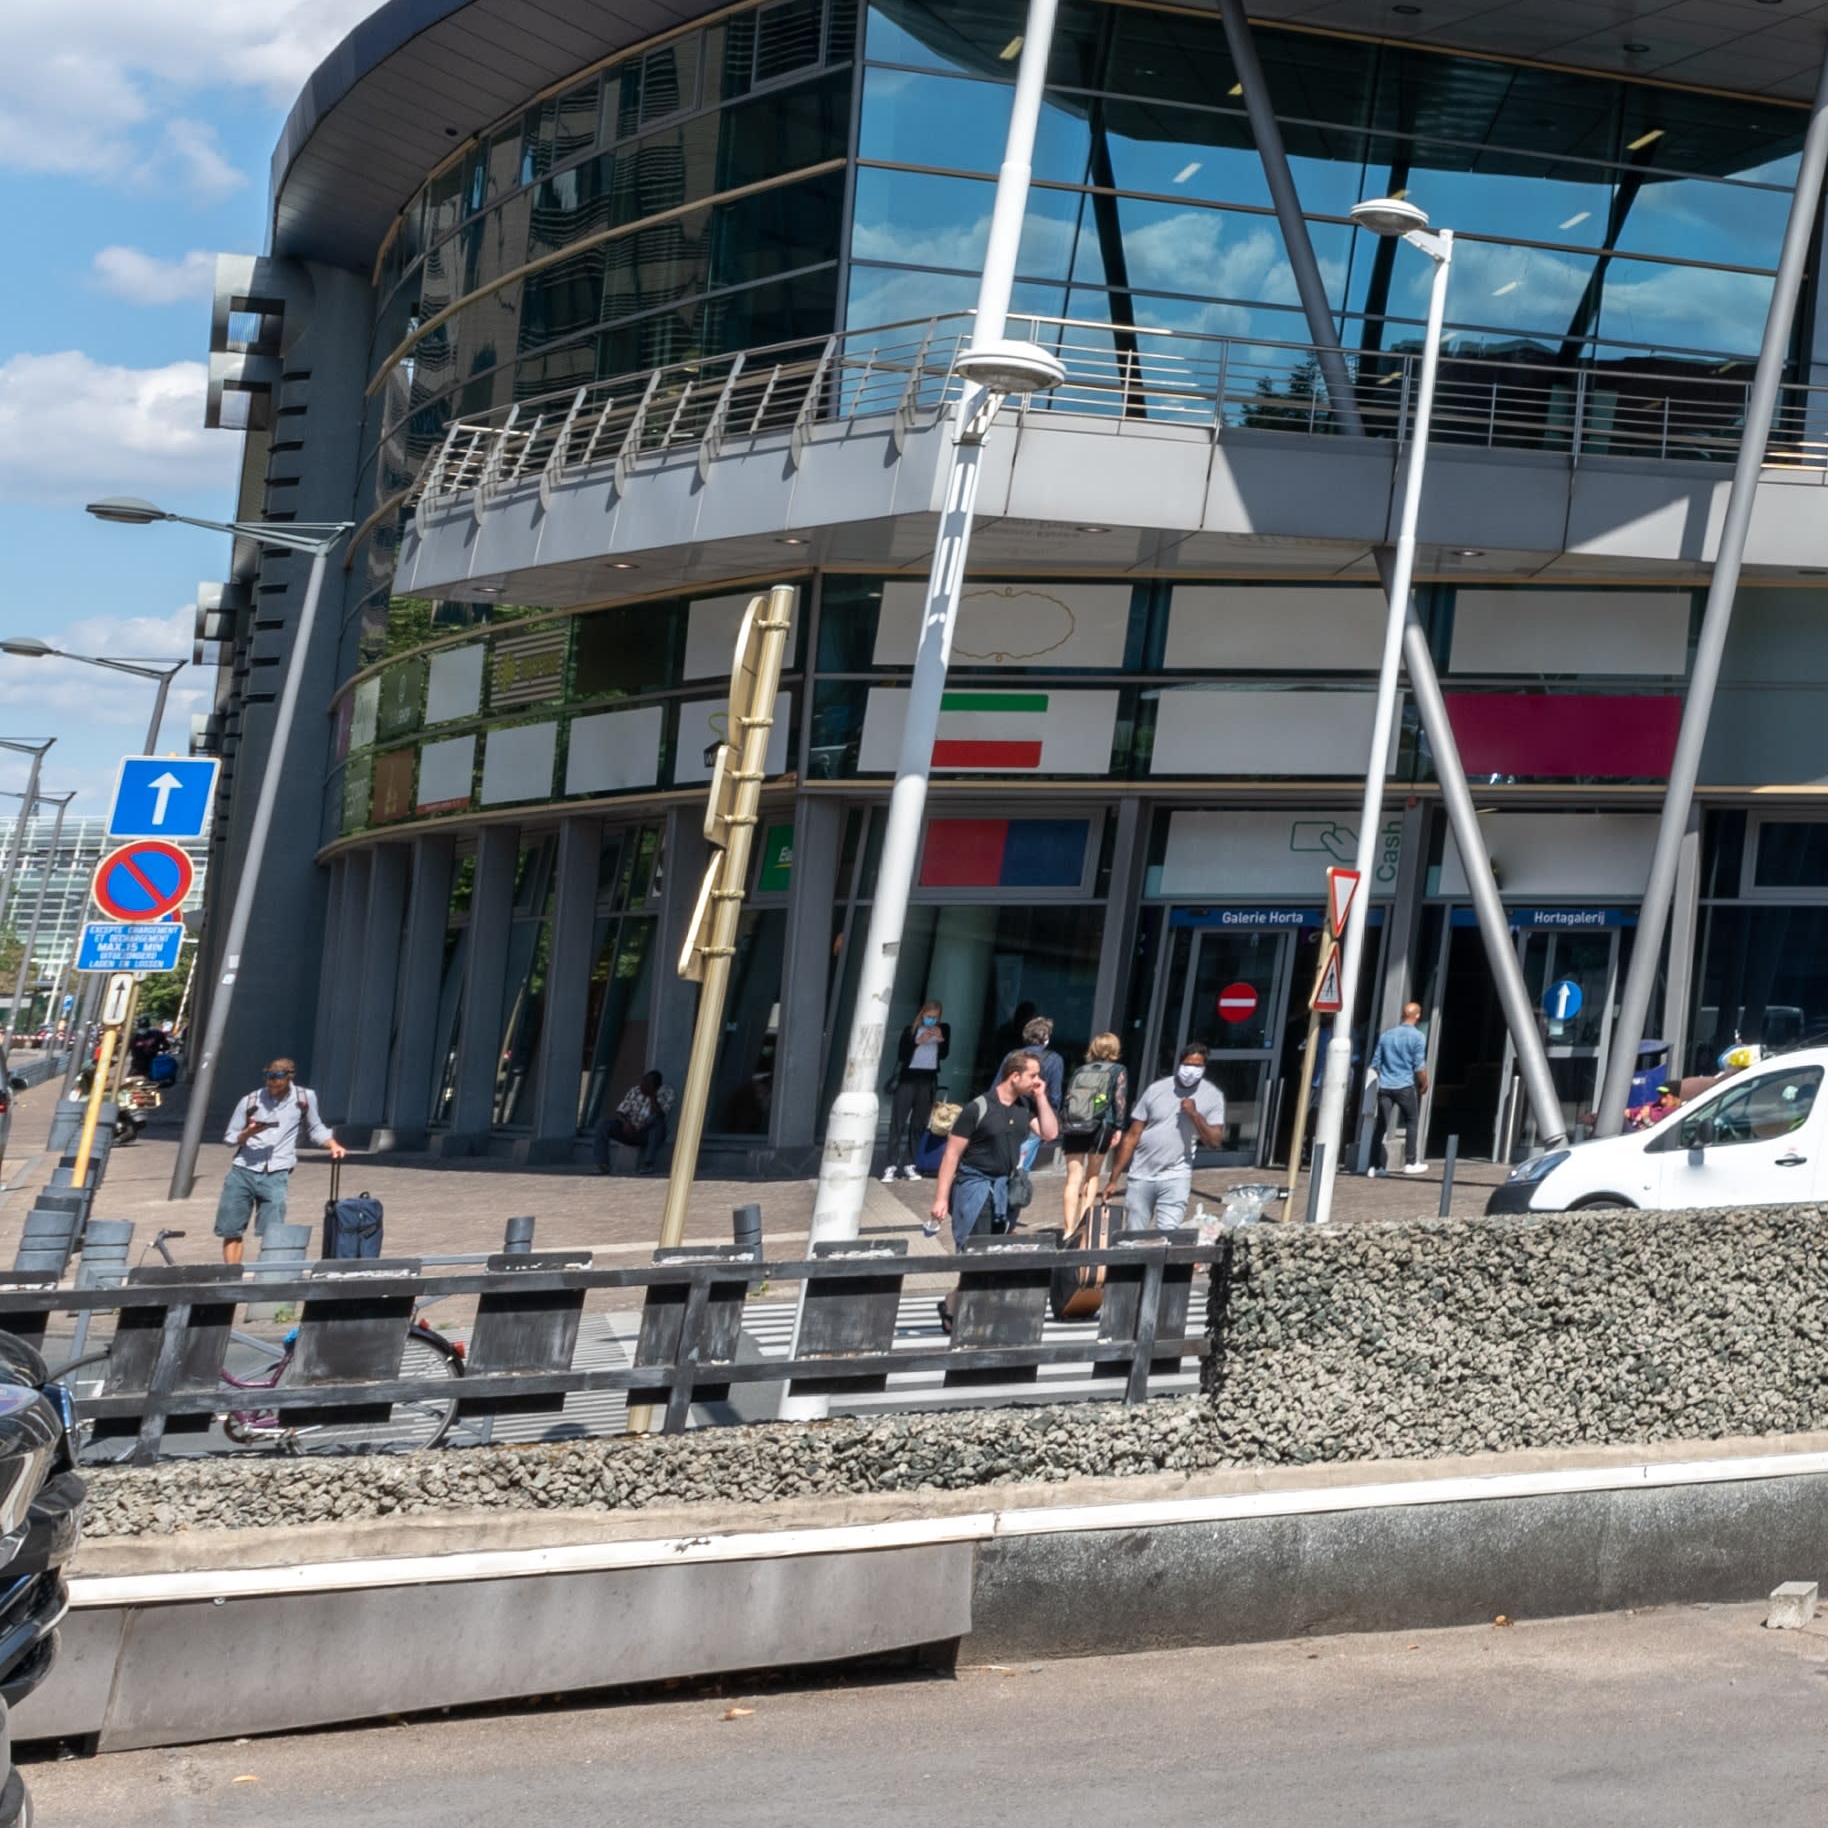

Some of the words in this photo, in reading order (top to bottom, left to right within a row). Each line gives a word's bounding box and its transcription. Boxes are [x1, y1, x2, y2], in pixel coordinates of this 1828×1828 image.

[1376, 821, 1403, 883] Cash
[1222, 911, 1267, 924] Galerie
[1269, 911, 1304, 924] Horta
[1534, 911, 1606, 926] Hortagalerij
[142, 942, 164, 952] MIN
